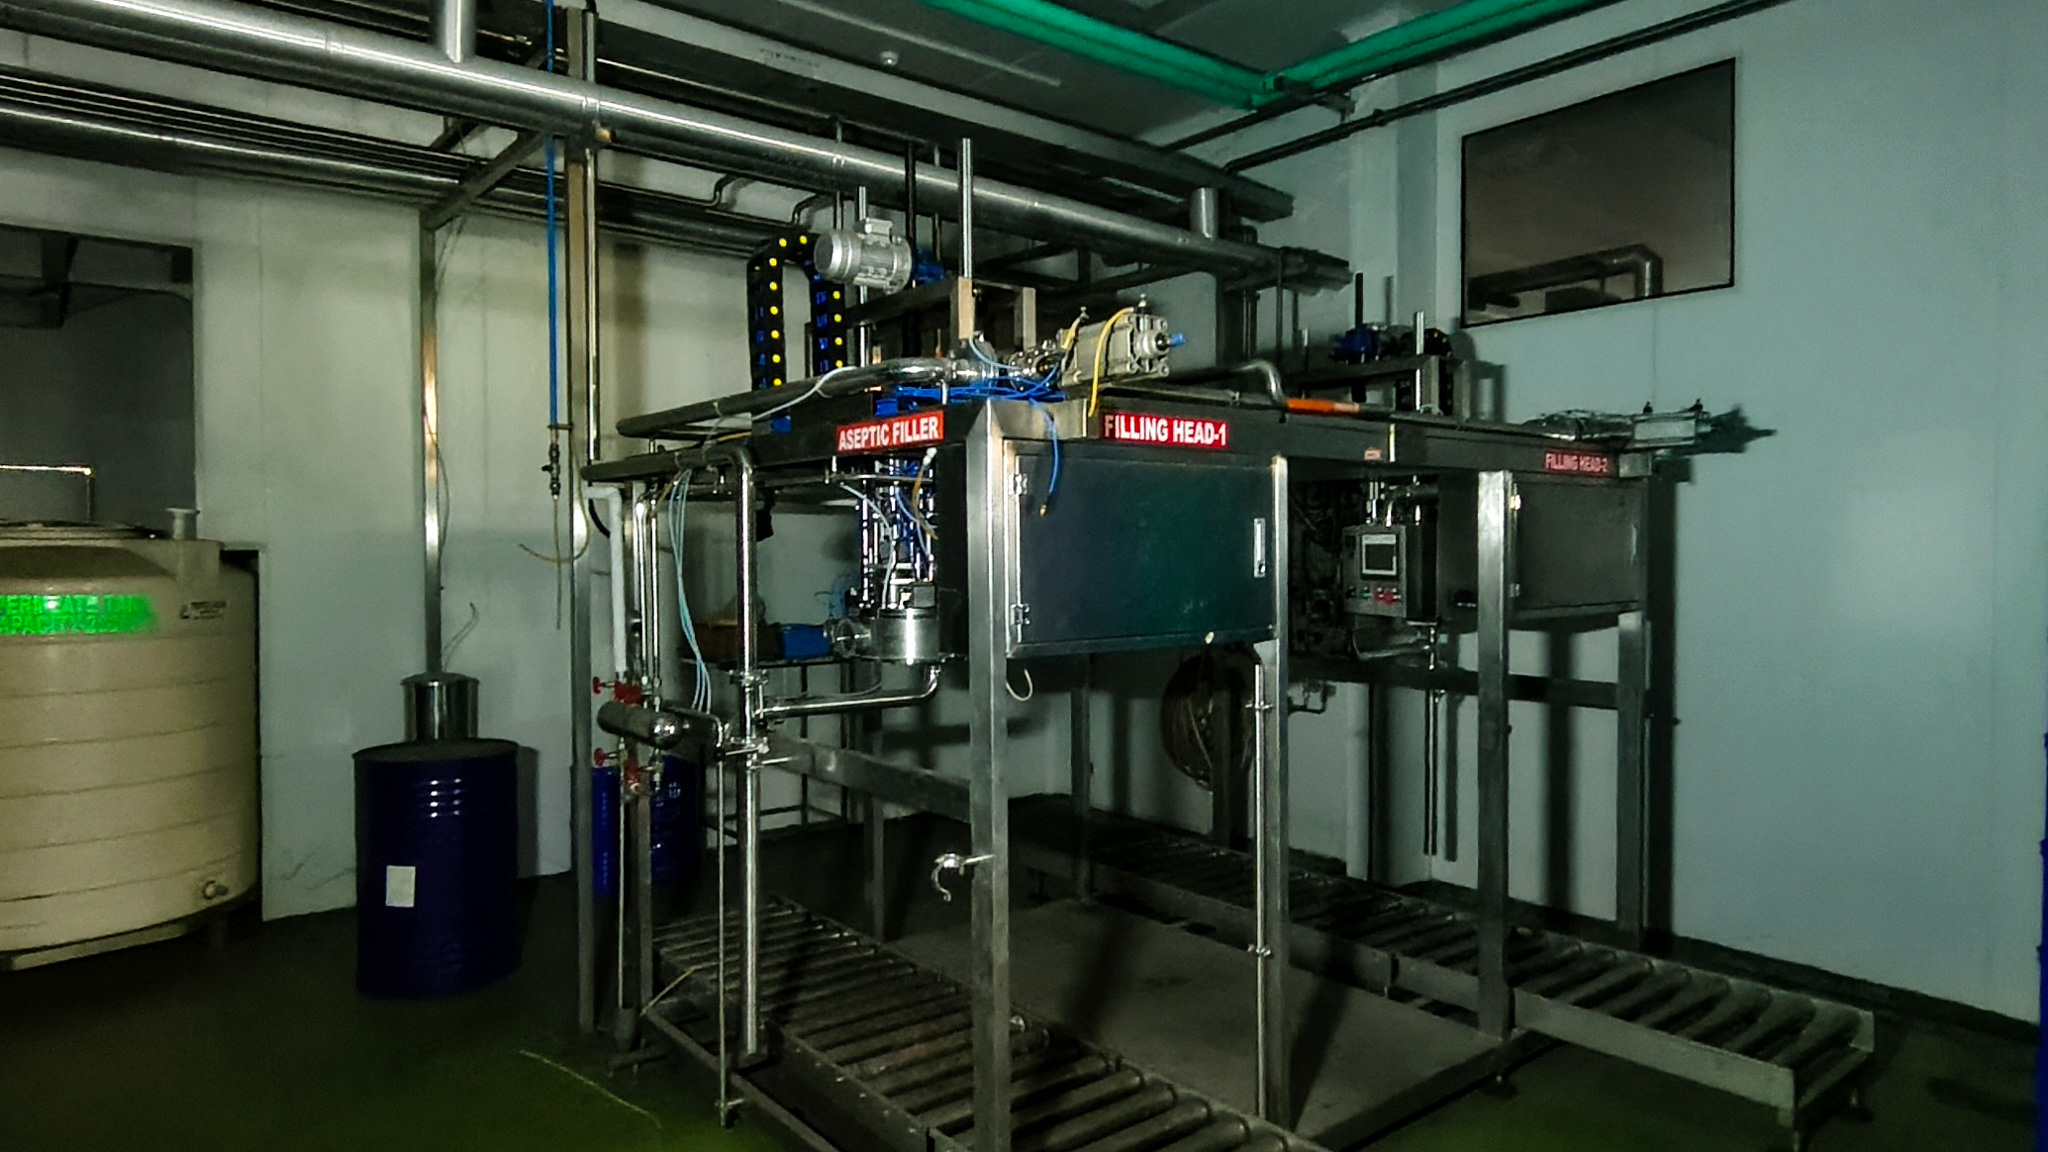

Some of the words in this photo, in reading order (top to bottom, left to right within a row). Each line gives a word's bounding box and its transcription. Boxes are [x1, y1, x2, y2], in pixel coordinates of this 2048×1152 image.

[838, 423, 890, 451] ASEPTIC
[892, 416, 938, 445] FILLER
[1104, 414, 1168, 442] FILLING
[1172, 419, 1226, 446] HEAD-1
